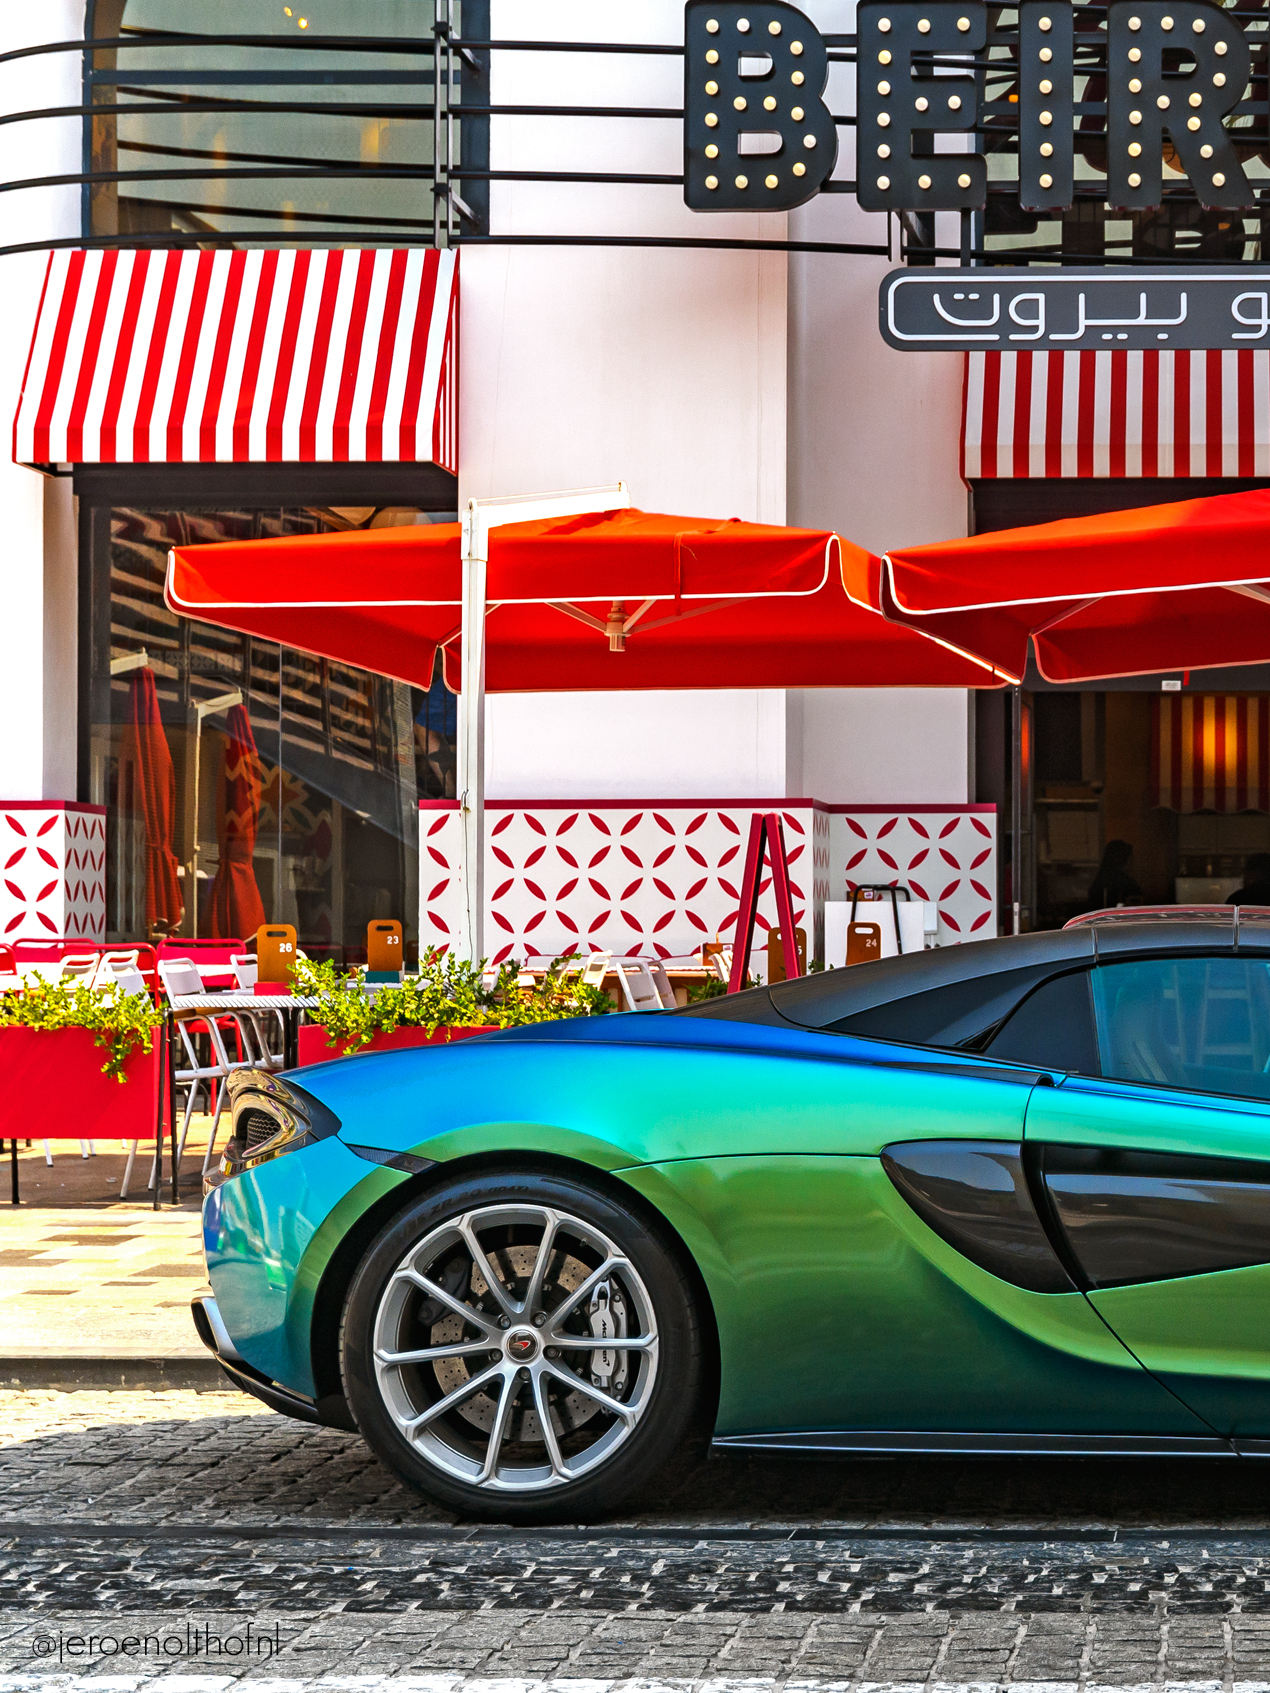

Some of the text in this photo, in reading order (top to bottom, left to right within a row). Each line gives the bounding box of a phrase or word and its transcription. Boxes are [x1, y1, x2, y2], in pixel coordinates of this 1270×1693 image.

[932, 292, 1188, 342] بيروت
[386, 935, 399, 945] 23
[865, 938, 878, 948] 24
[279, 942, 293, 953] 26
